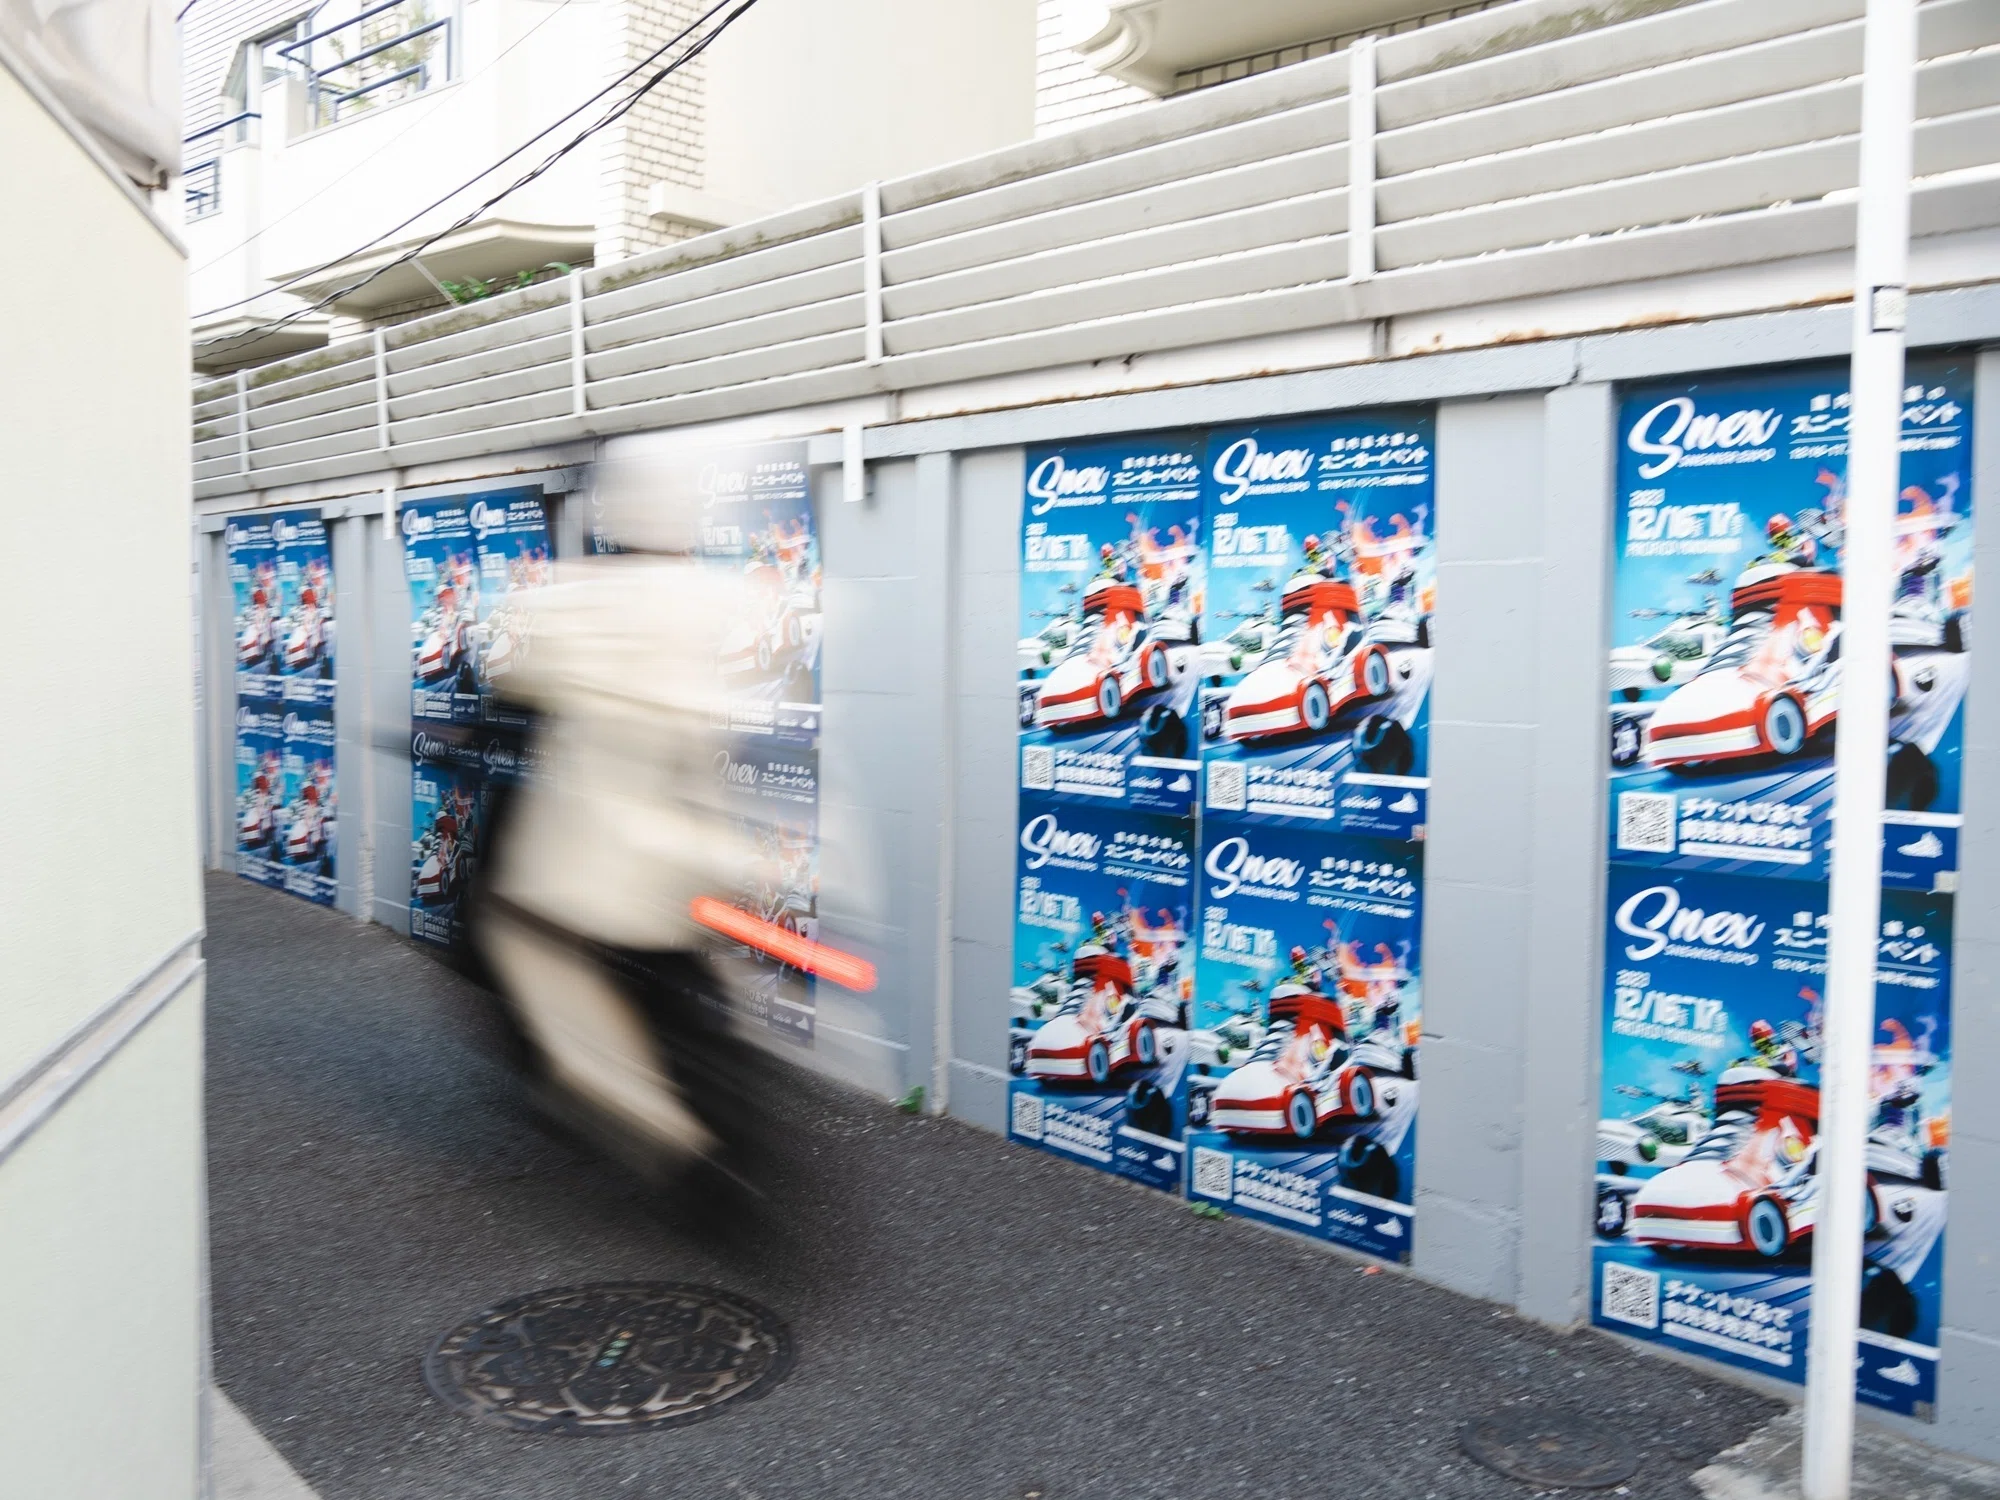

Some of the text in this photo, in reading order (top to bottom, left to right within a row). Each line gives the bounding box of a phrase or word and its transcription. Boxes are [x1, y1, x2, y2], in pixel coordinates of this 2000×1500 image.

[1627, 397, 1783, 479] Snex
[1027, 455, 1109, 516] Snex
[1213, 437, 1314, 506] Snex
[1020, 813, 1103, 871] Snex
[1204, 837, 1305, 900] Snex
[1614, 885, 1766, 961] Snex
